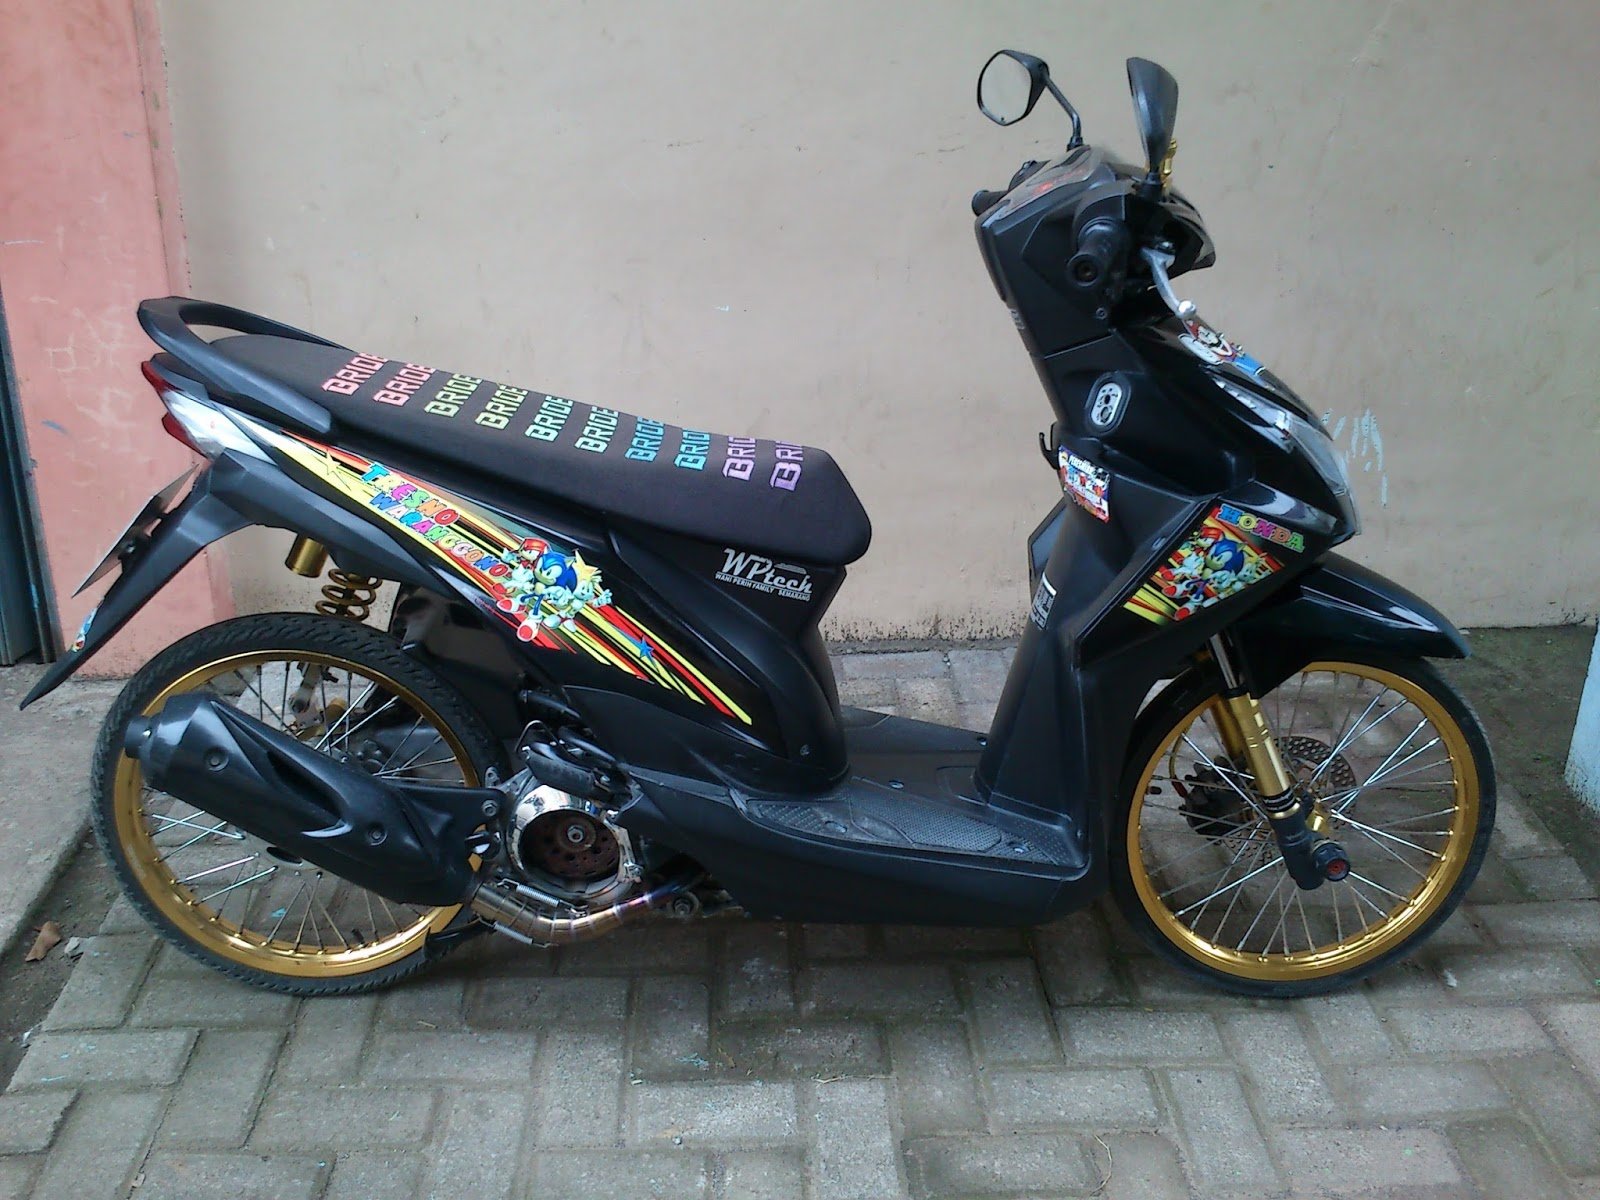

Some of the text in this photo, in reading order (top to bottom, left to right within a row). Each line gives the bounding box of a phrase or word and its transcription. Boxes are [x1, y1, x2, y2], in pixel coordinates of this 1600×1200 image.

[321, 352, 389, 396] BRIDE
[372, 363, 437, 407] BRIDE
[423, 373, 483, 418] BRIDE
[474, 384, 529, 430] BRIDE
[524, 395, 574, 442] BRIDE
[574, 406, 619, 453] BRIDE
[624, 416, 665, 463] BRIDE
[673, 428, 711, 471] BRID
[361, 462, 460, 526] TRESNO
[1215, 503, 1305, 553] HONDA
[752, 582, 775, 594] FAMILY
[778, 588, 811, 602] SEMARANG
